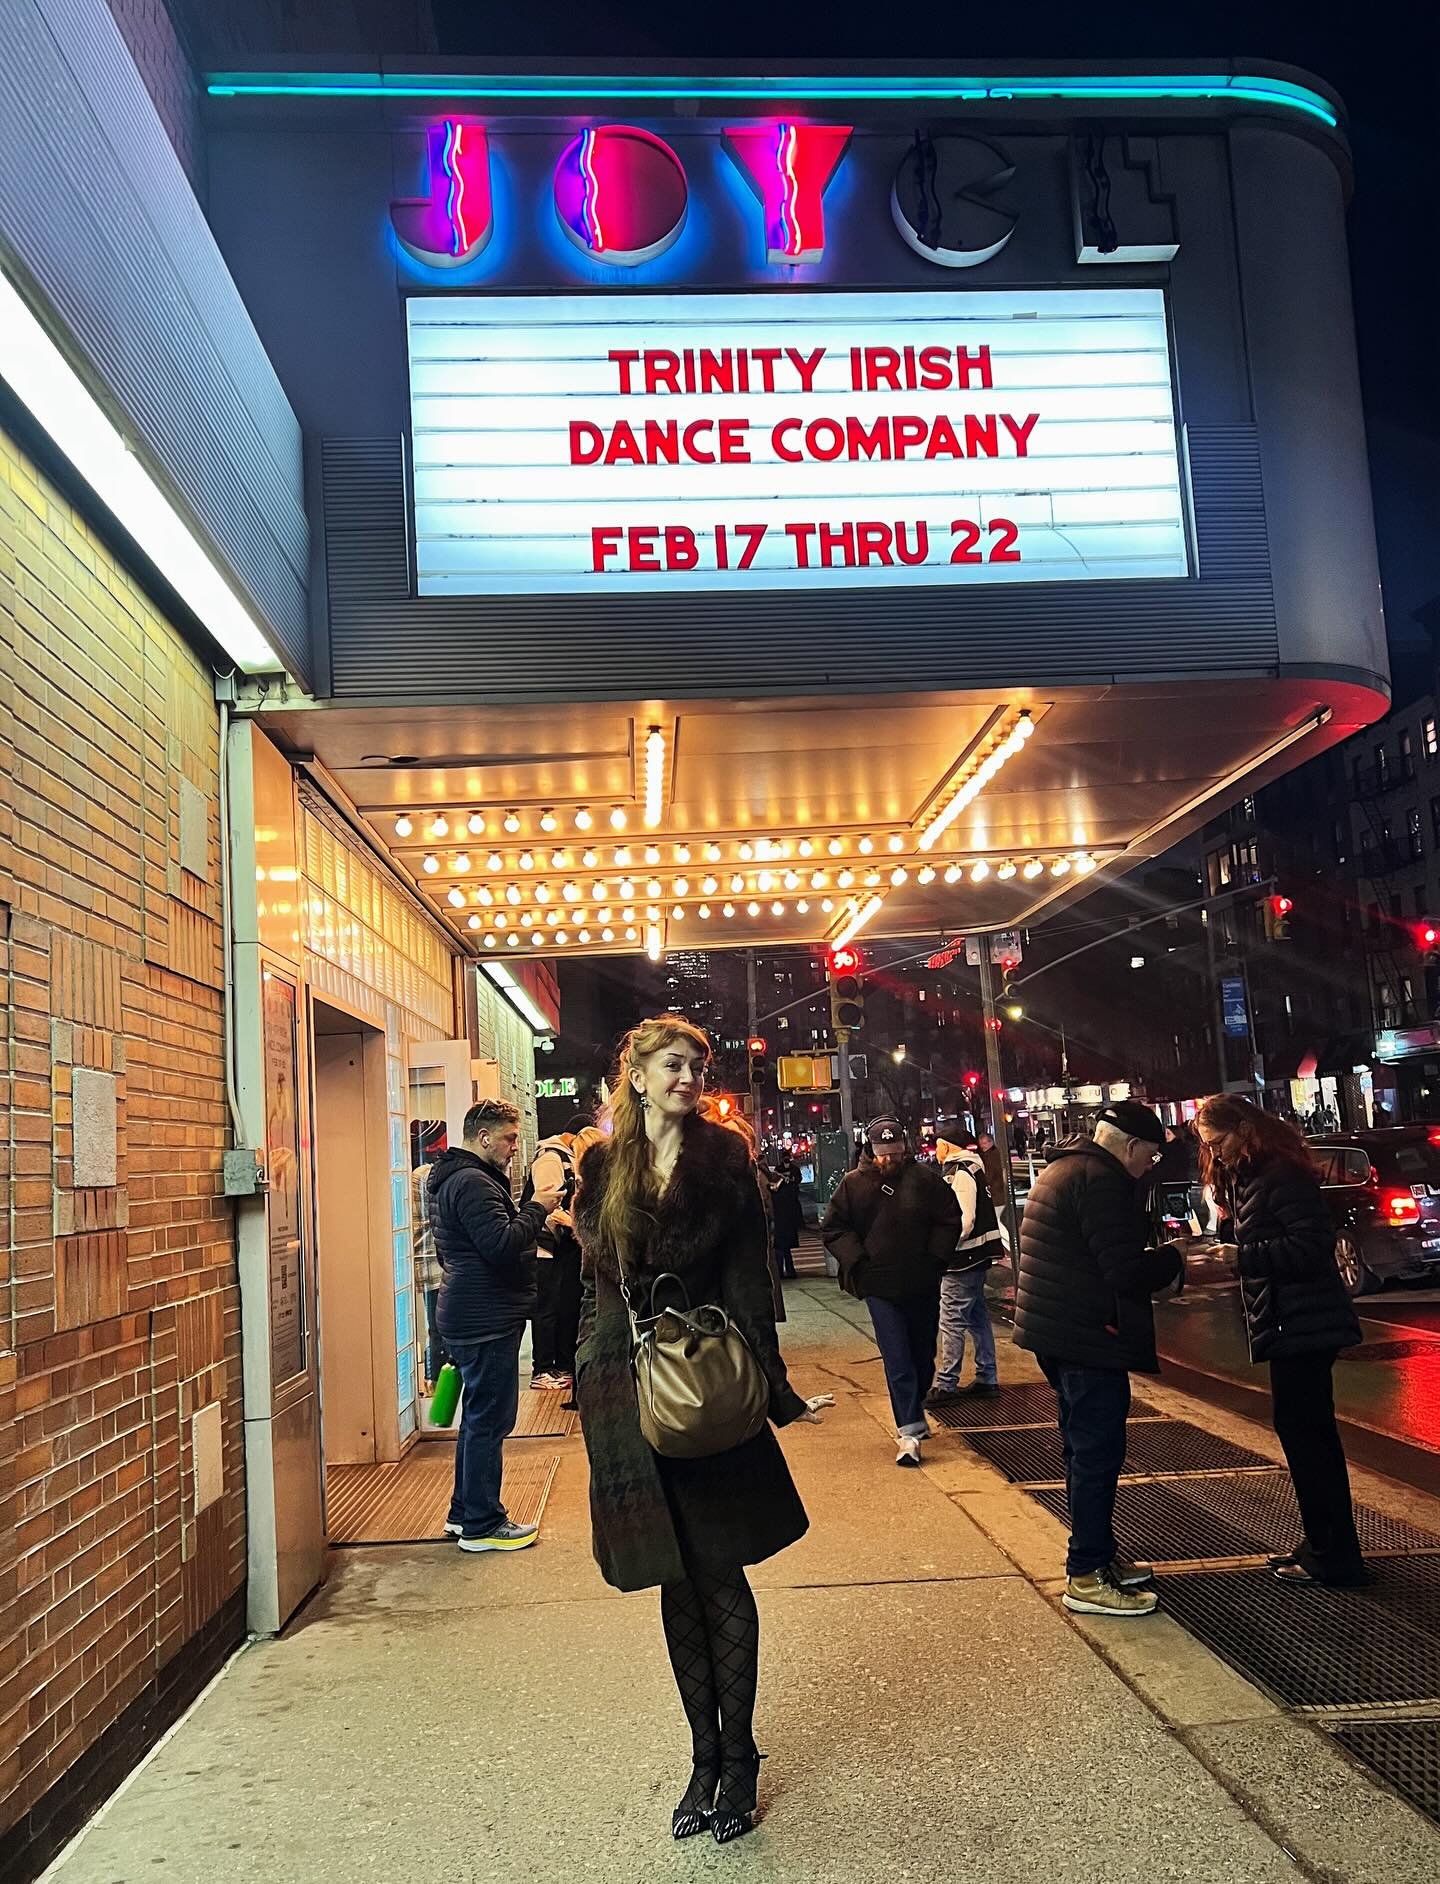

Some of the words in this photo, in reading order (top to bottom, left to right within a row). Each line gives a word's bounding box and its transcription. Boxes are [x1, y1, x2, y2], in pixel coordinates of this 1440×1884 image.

[389, 122, 1180, 268] JOYCE
[608, 347, 826, 395] TRINITY
[850, 345, 993, 392] IRISH
[569, 418, 751, 465] DANCE
[771, 414, 1039, 463] COMPANY
[591, 525, 699, 573] FEB
[715, 524, 767, 570] 17
[784, 521, 929, 568] THRU
[950, 518, 1021, 565] 22
